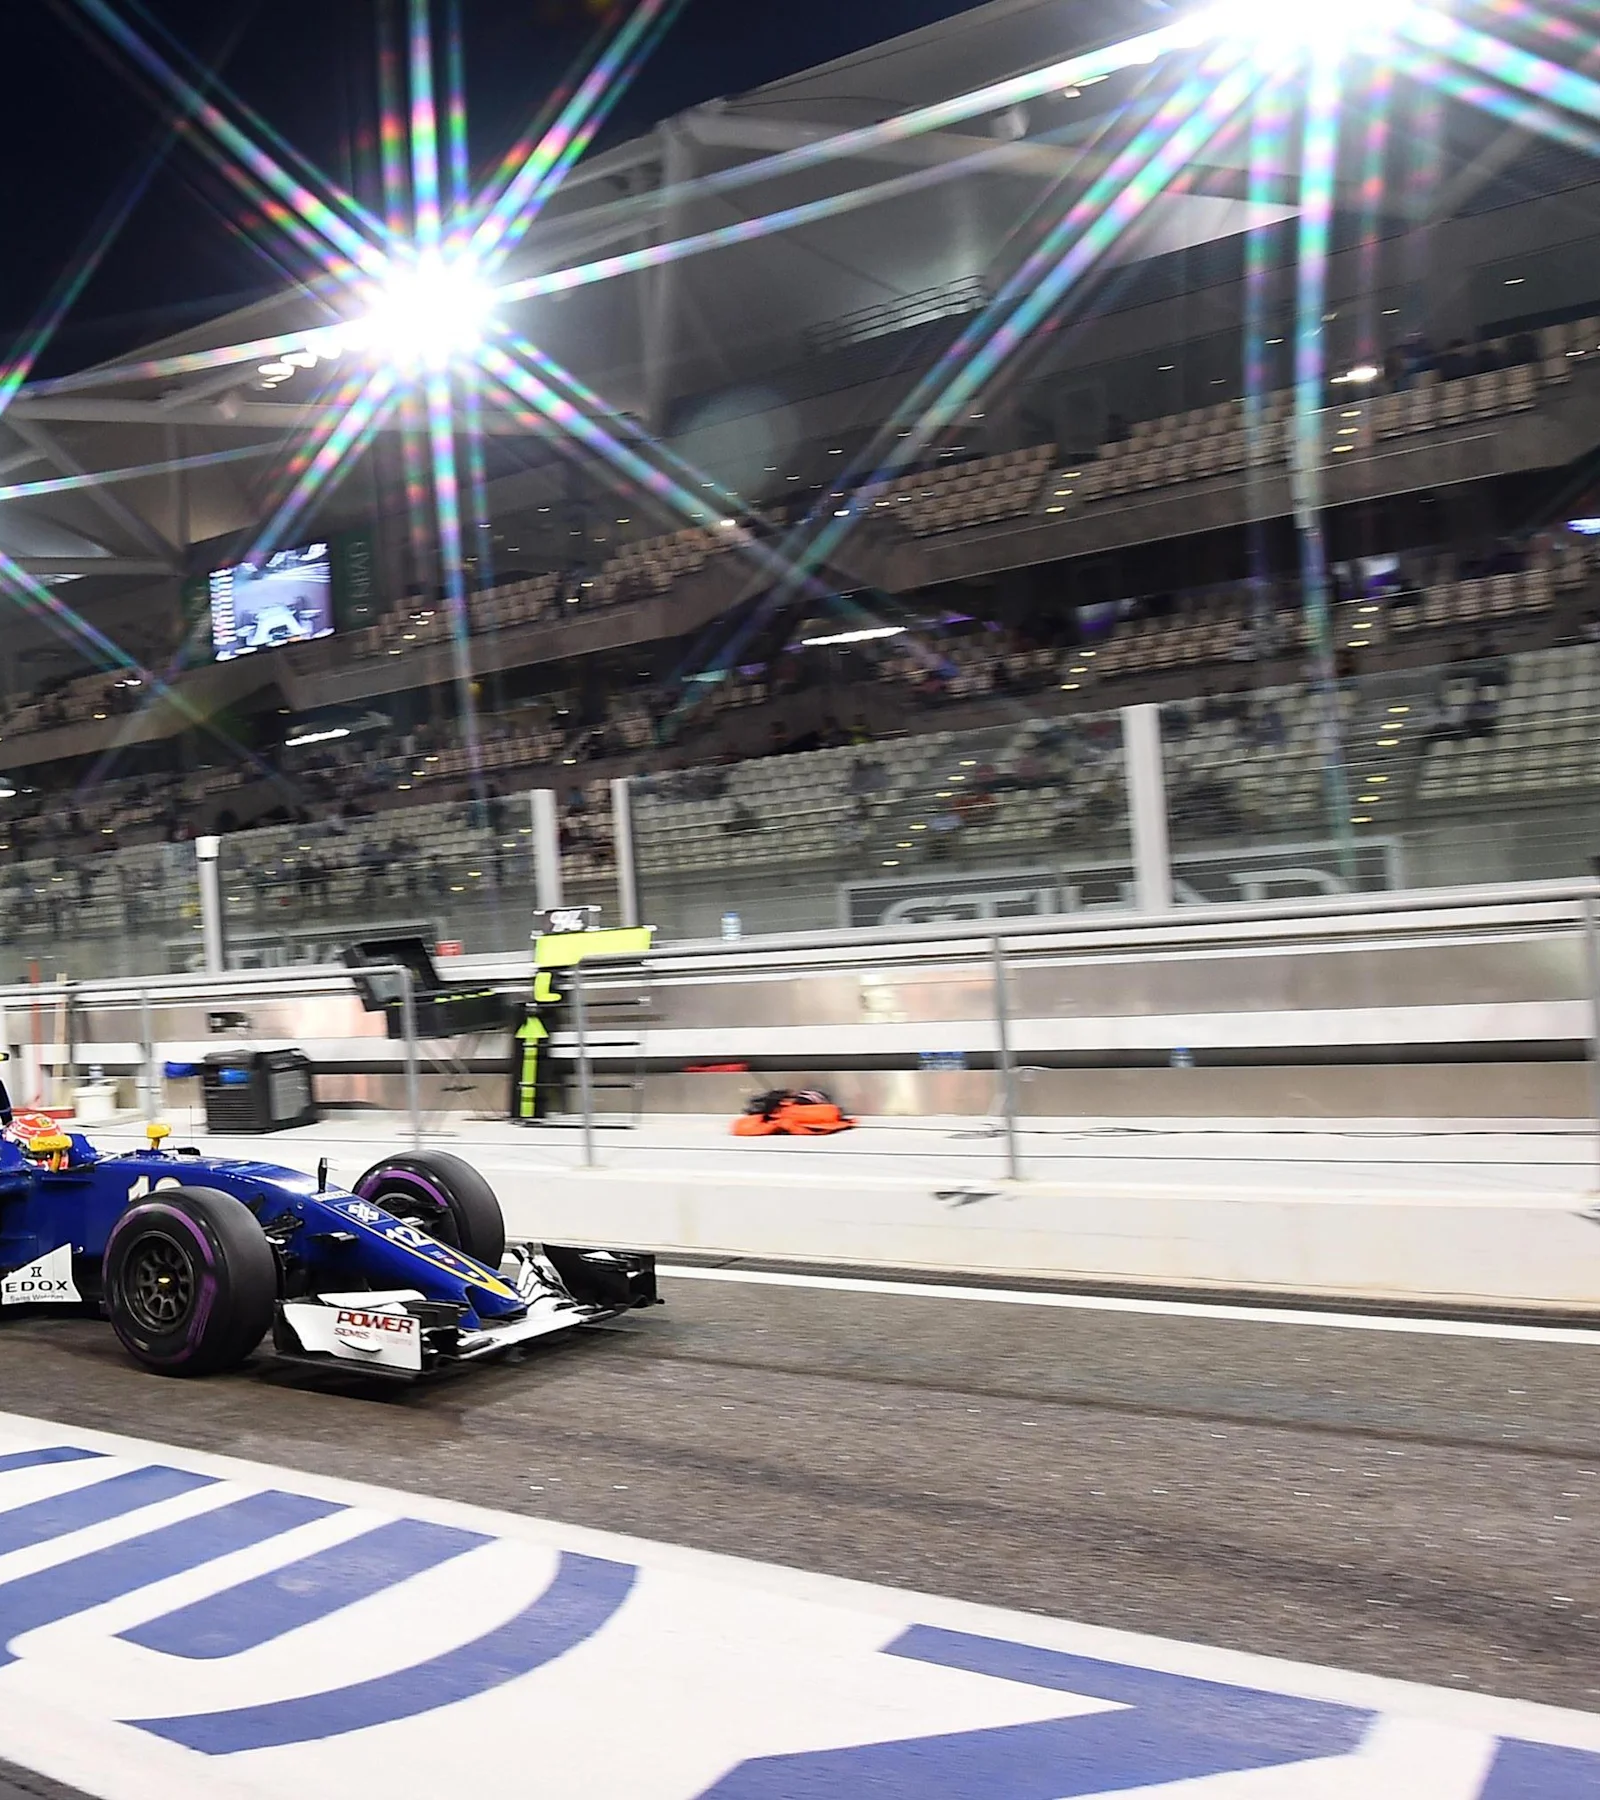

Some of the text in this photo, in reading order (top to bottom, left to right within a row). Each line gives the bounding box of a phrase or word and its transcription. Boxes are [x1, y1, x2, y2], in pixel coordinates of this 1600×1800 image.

[385, 1225, 434, 1248] 12
[5, 1280, 68, 1293] EDOX
[336, 1310, 414, 1334] POWER
